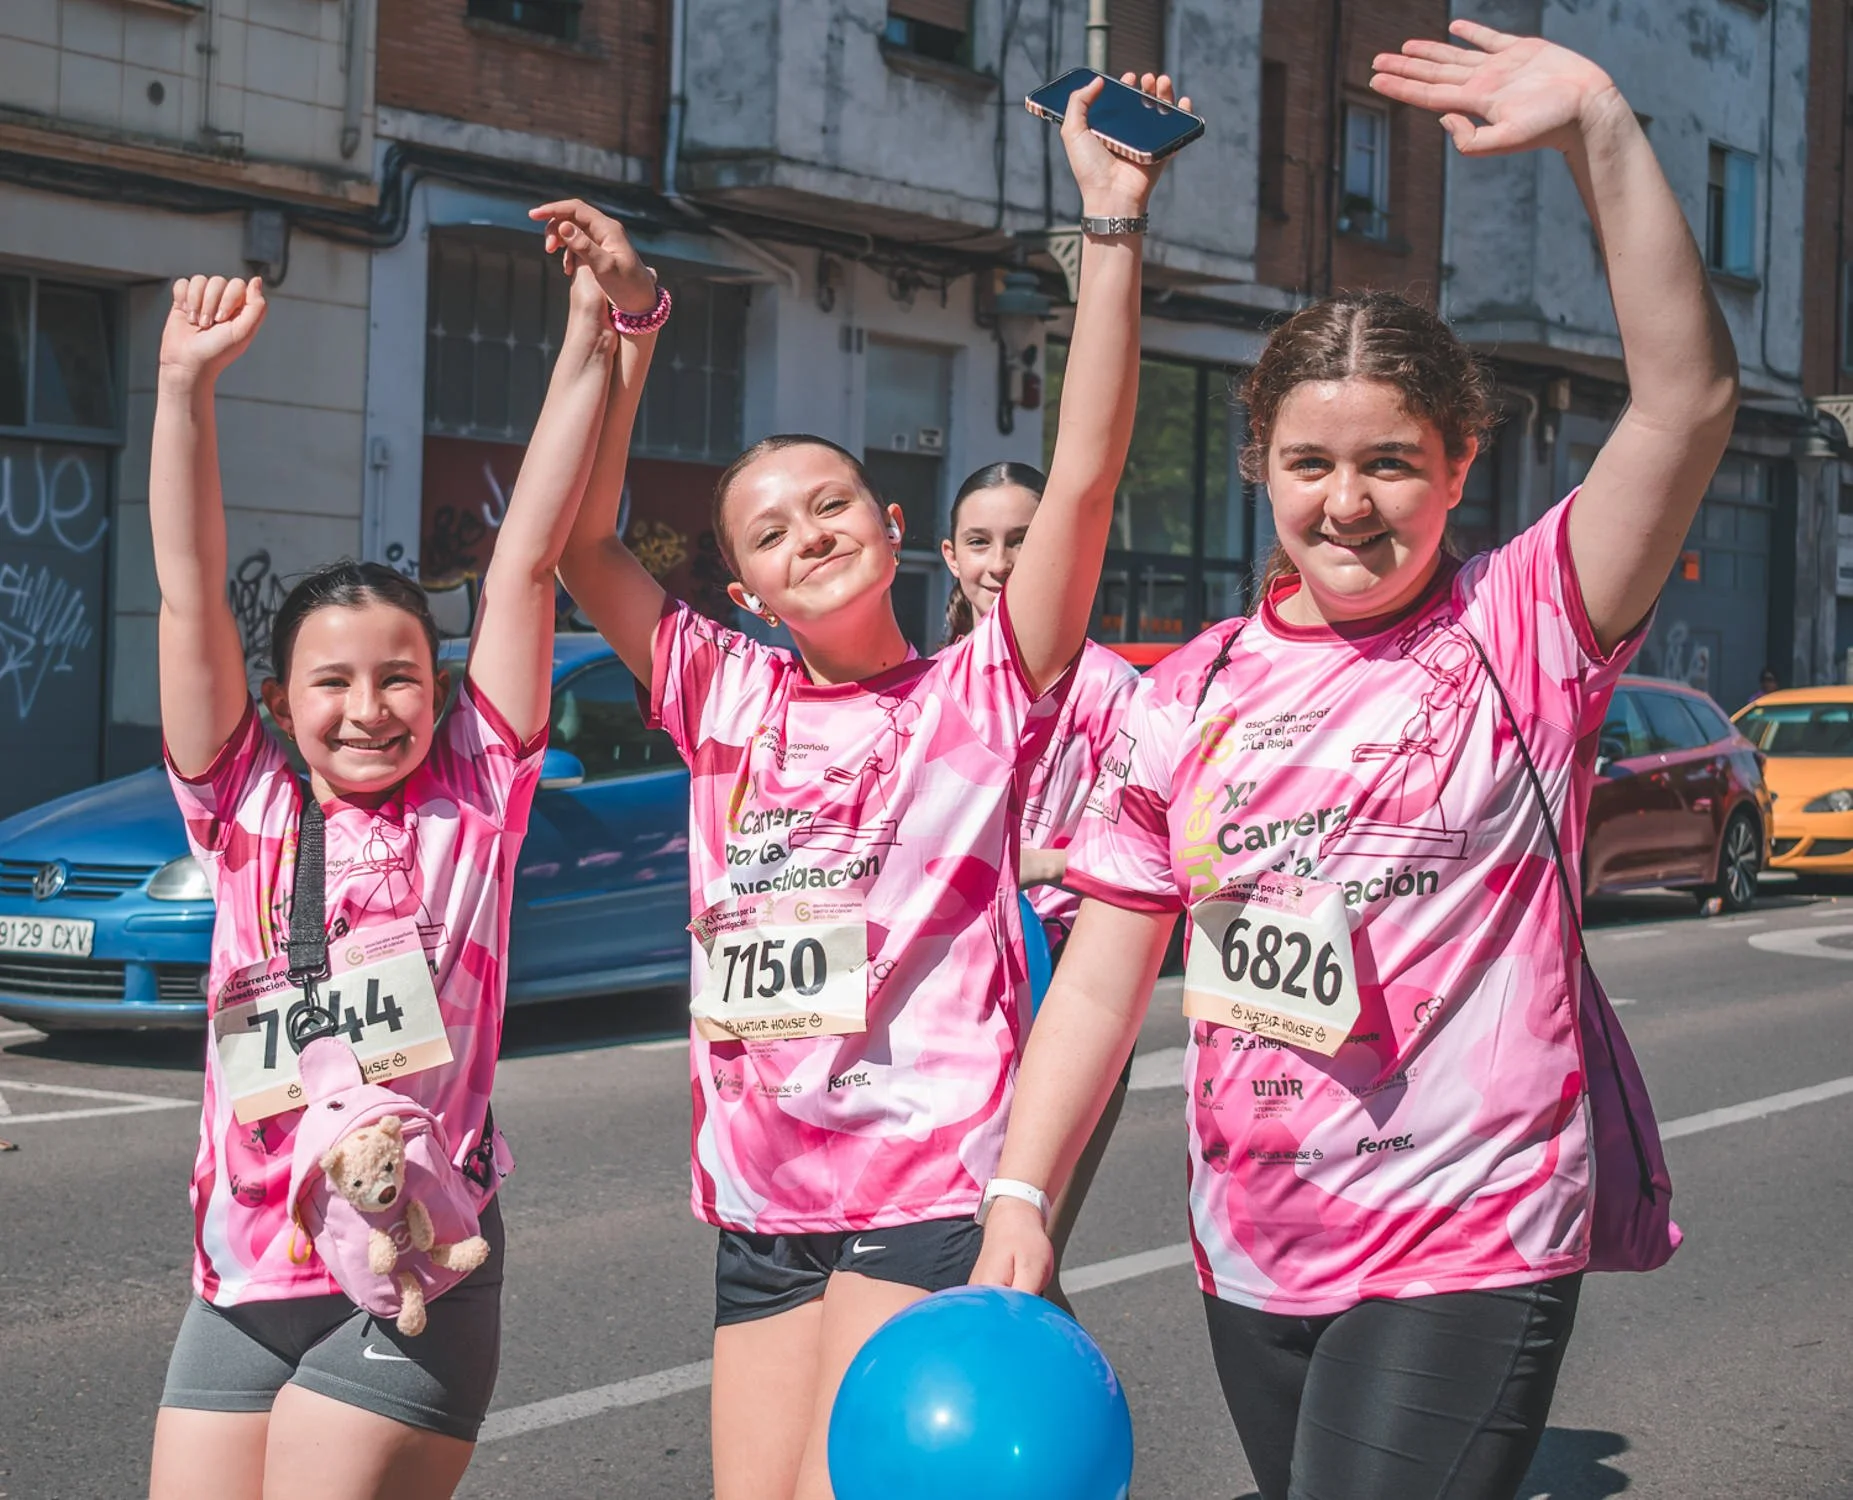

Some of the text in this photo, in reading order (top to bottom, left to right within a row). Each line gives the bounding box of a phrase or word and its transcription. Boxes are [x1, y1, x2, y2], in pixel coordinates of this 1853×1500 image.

[1251, 739, 1264, 750] La
[1267, 738, 1293, 750] Rioja
[740, 807, 813, 835] Carrera
[1216, 804, 1348, 856] Carrera
[759, 839, 787, 865] la
[1177, 785, 1222, 896] ujer
[731, 854, 880, 896] nvestigación
[1220, 882, 1259, 893] arrera
[1260, 884, 1276, 895] por
[0, 920, 88, 952] 9129 CXV
[722, 937, 827, 1003] 7150
[1221, 917, 1343, 1007] 6826
[236, 973, 272, 990] Carrera
[272, 968, 287, 981] po
[224, 980, 287, 1004] Investigación
[736, 1017, 806, 1033] NATUR HOUSE
[1282, 1018, 1314, 1039] HOUSE
[1345, 1032, 1380, 1045] eporte
[361, 1059, 391, 1076] USE
